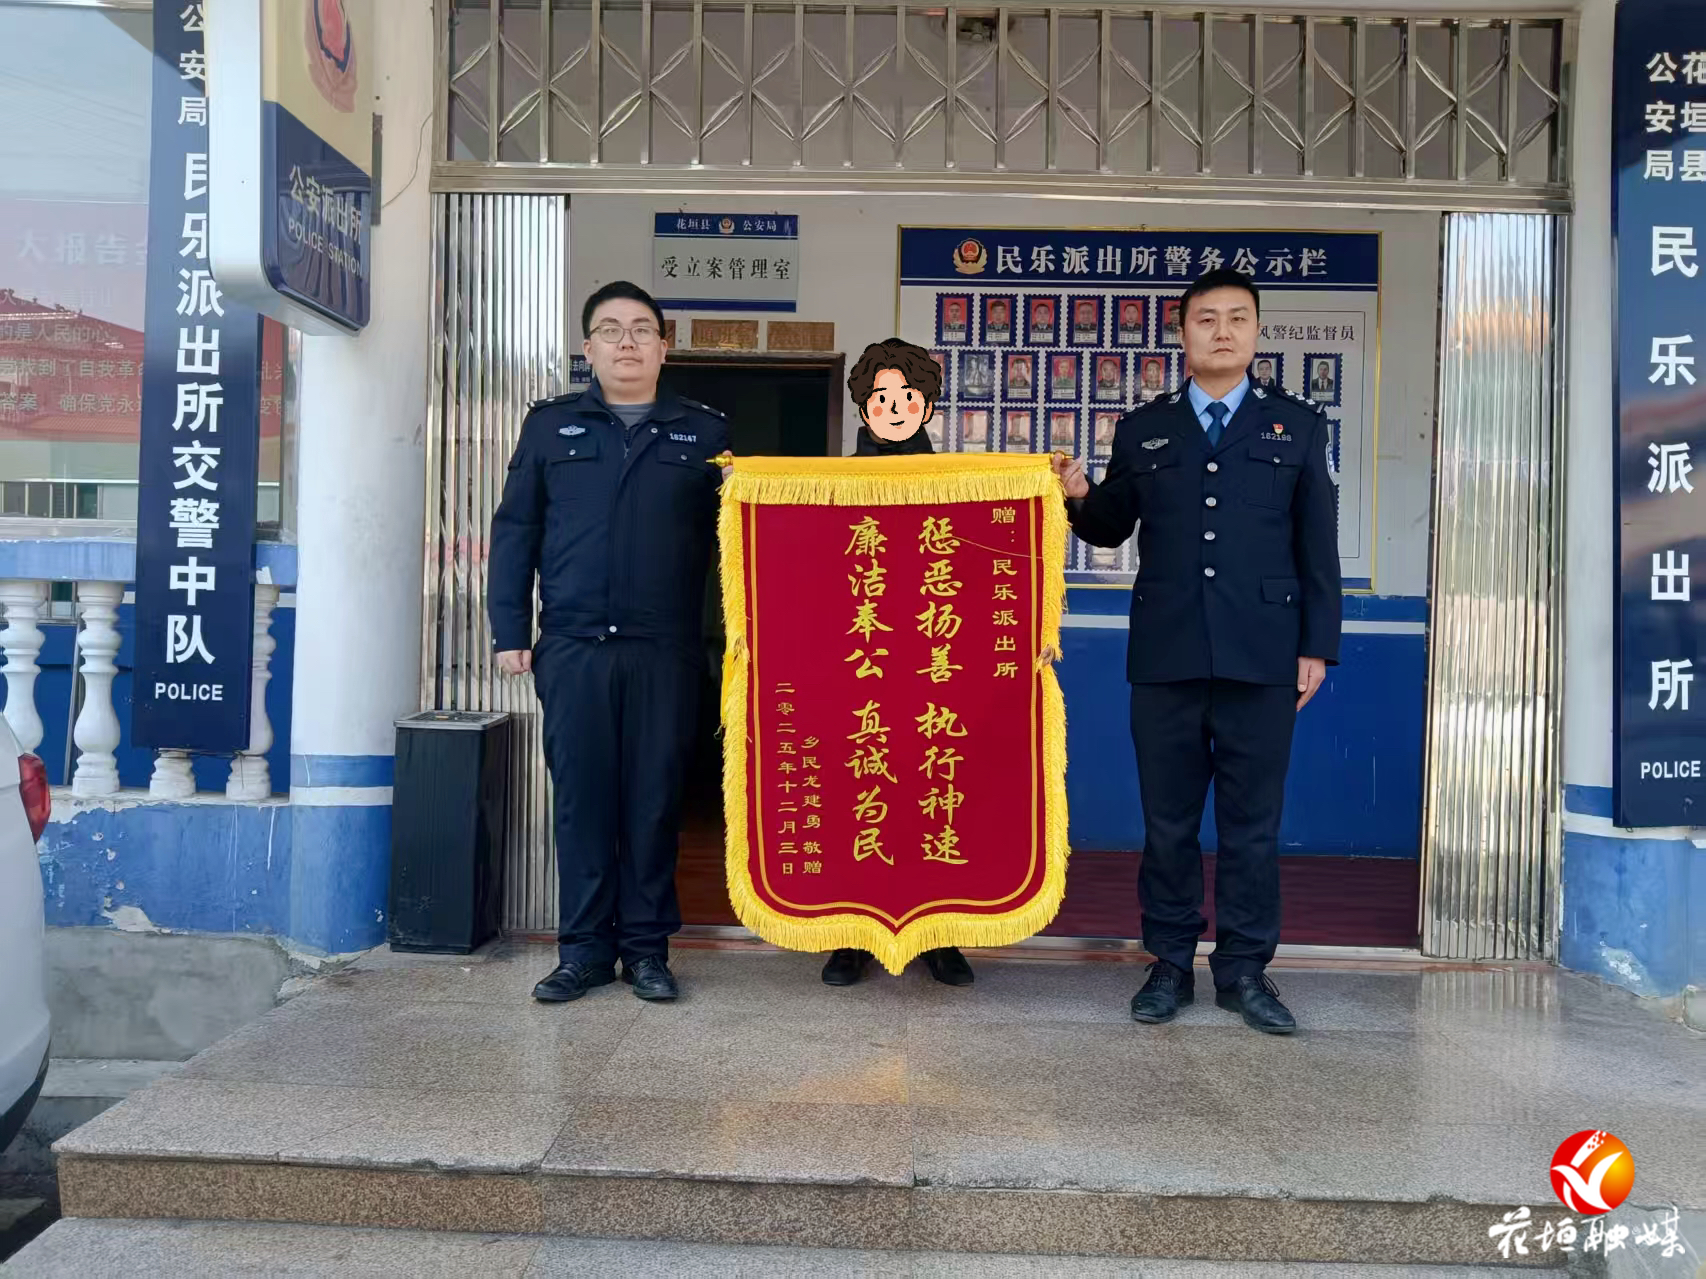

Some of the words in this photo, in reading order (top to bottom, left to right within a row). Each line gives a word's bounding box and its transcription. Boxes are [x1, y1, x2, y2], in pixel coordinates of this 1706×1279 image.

[178, 4, 207, 126] 公安局
[1643, 52, 1678, 181] 公安局
[1679, 52, 1706, 181] 花垣县
[288, 217, 324, 254] POLICE
[328, 242, 363, 276] STATION
[289, 163, 362, 245] 公安派出所
[677, 217, 711, 231] 花垣县
[743, 219, 777, 232] 公安局
[661, 255, 791, 280] 受立案管理室
[996, 245, 1328, 277] 民乐派出所警务公示栏
[59, 392, 142, 419] 确保党永
[1647, 225, 1700, 712] 民乐派出所
[844, 515, 895, 679] 廉洁奉公
[915, 515, 964, 684] 惩恶扬善
[992, 558, 1018, 679] 民乐派出所
[155, 682, 223, 701] POLICE
[775, 682, 798, 875] 二零二五年十二月三日
[801, 735, 822, 829] 乡民龙建勇
[844, 699, 899, 866] 真诚为民
[914, 702, 969, 865] 执行神速
[1641, 760, 1701, 779] POLICE
[802, 841, 822, 874] 敬赠
